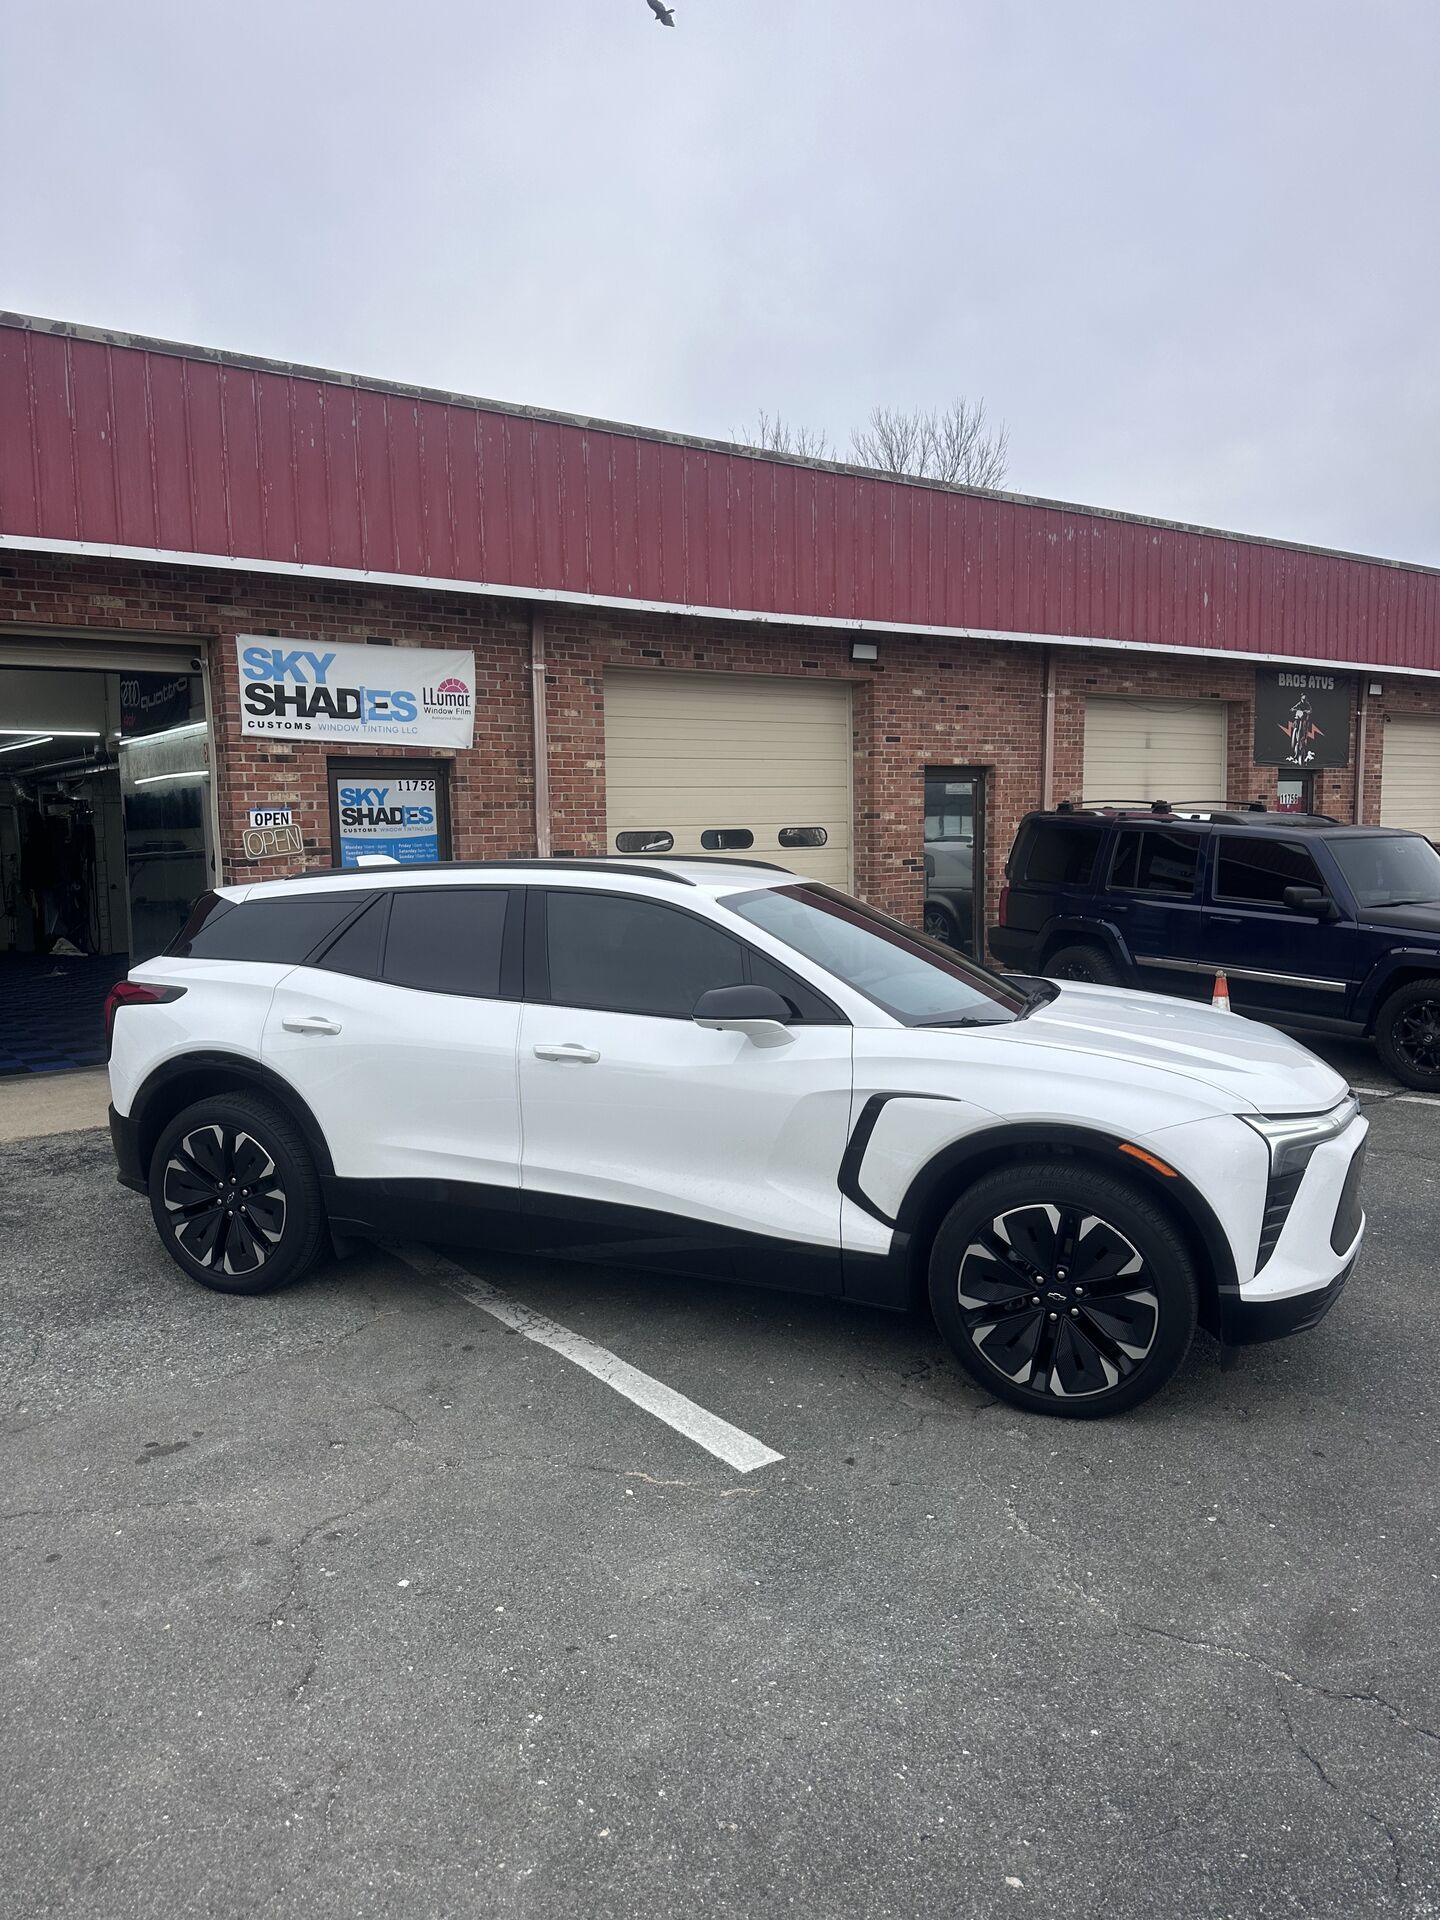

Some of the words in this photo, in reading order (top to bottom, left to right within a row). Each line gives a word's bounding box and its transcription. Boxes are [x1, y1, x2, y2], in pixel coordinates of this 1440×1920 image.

[242, 647, 336, 684] SKY
[1278, 672, 1306, 688] BROS
[1308, 675, 1335, 690] ATVS
[244, 682, 418, 725] SHADES
[422, 687, 470, 707] LLumar
[423, 706, 454, 715] Window
[247, 720, 312, 730] CUSTOMS
[318, 723, 360, 733] WINDOW
[362, 725, 400, 734] TINTING
[401, 726, 418, 735] LLC
[397, 780, 435, 792] 11752
[340, 787, 390, 806] SKY
[254, 812, 289, 826] OPEN
[341, 805, 434, 827] SHADES
[247, 828, 301, 856] OPEN
